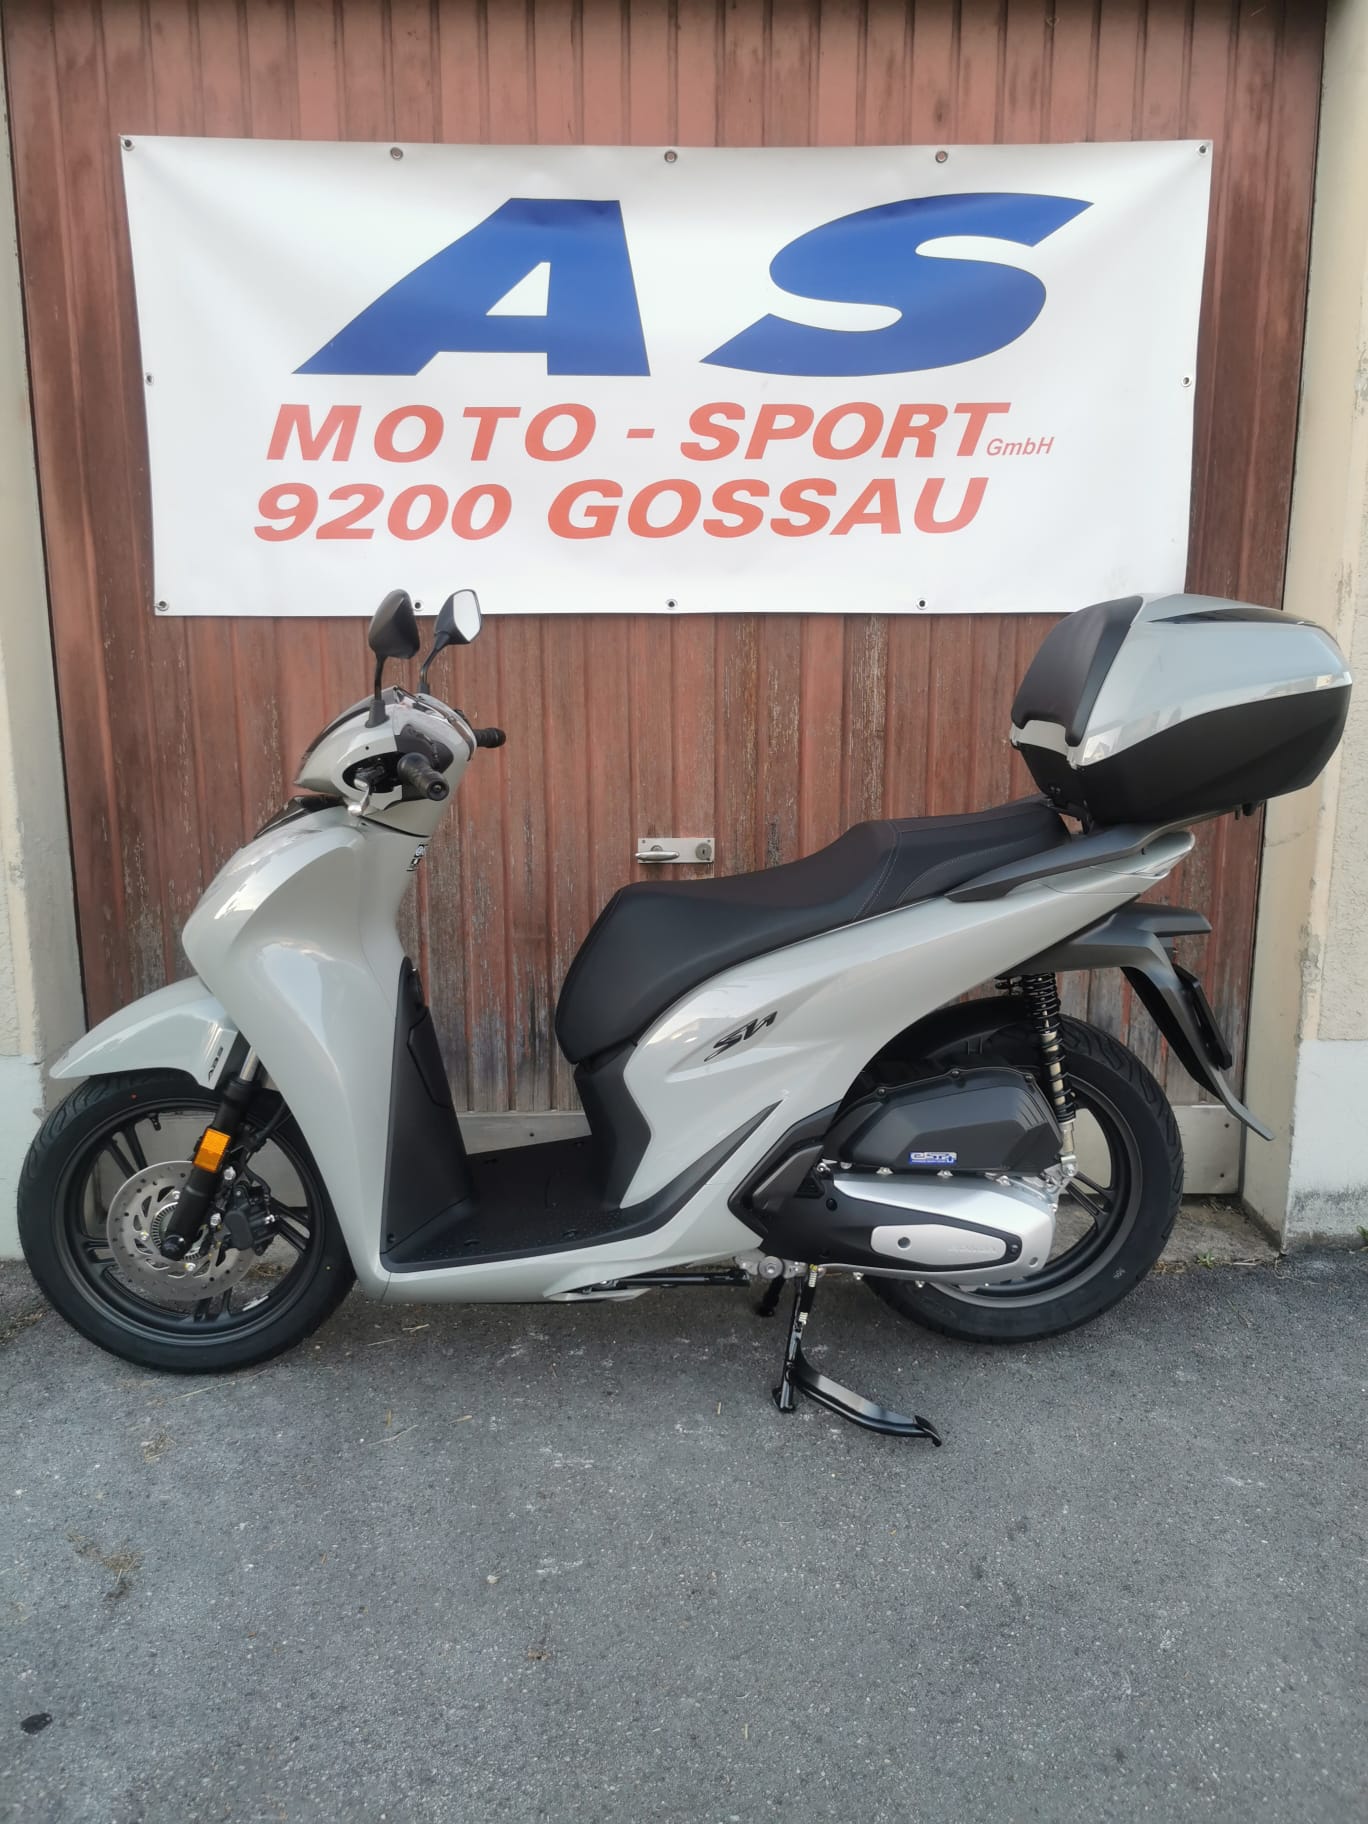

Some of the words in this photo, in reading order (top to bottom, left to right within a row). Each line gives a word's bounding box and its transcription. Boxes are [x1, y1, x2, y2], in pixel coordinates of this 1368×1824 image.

[266, 403, 597, 464] MOTO
[680, 401, 1011, 461] SPORT
[985, 436, 1054, 457] GmbH
[254, 482, 512, 542] 9200
[547, 477, 989, 540] GOSSAU
